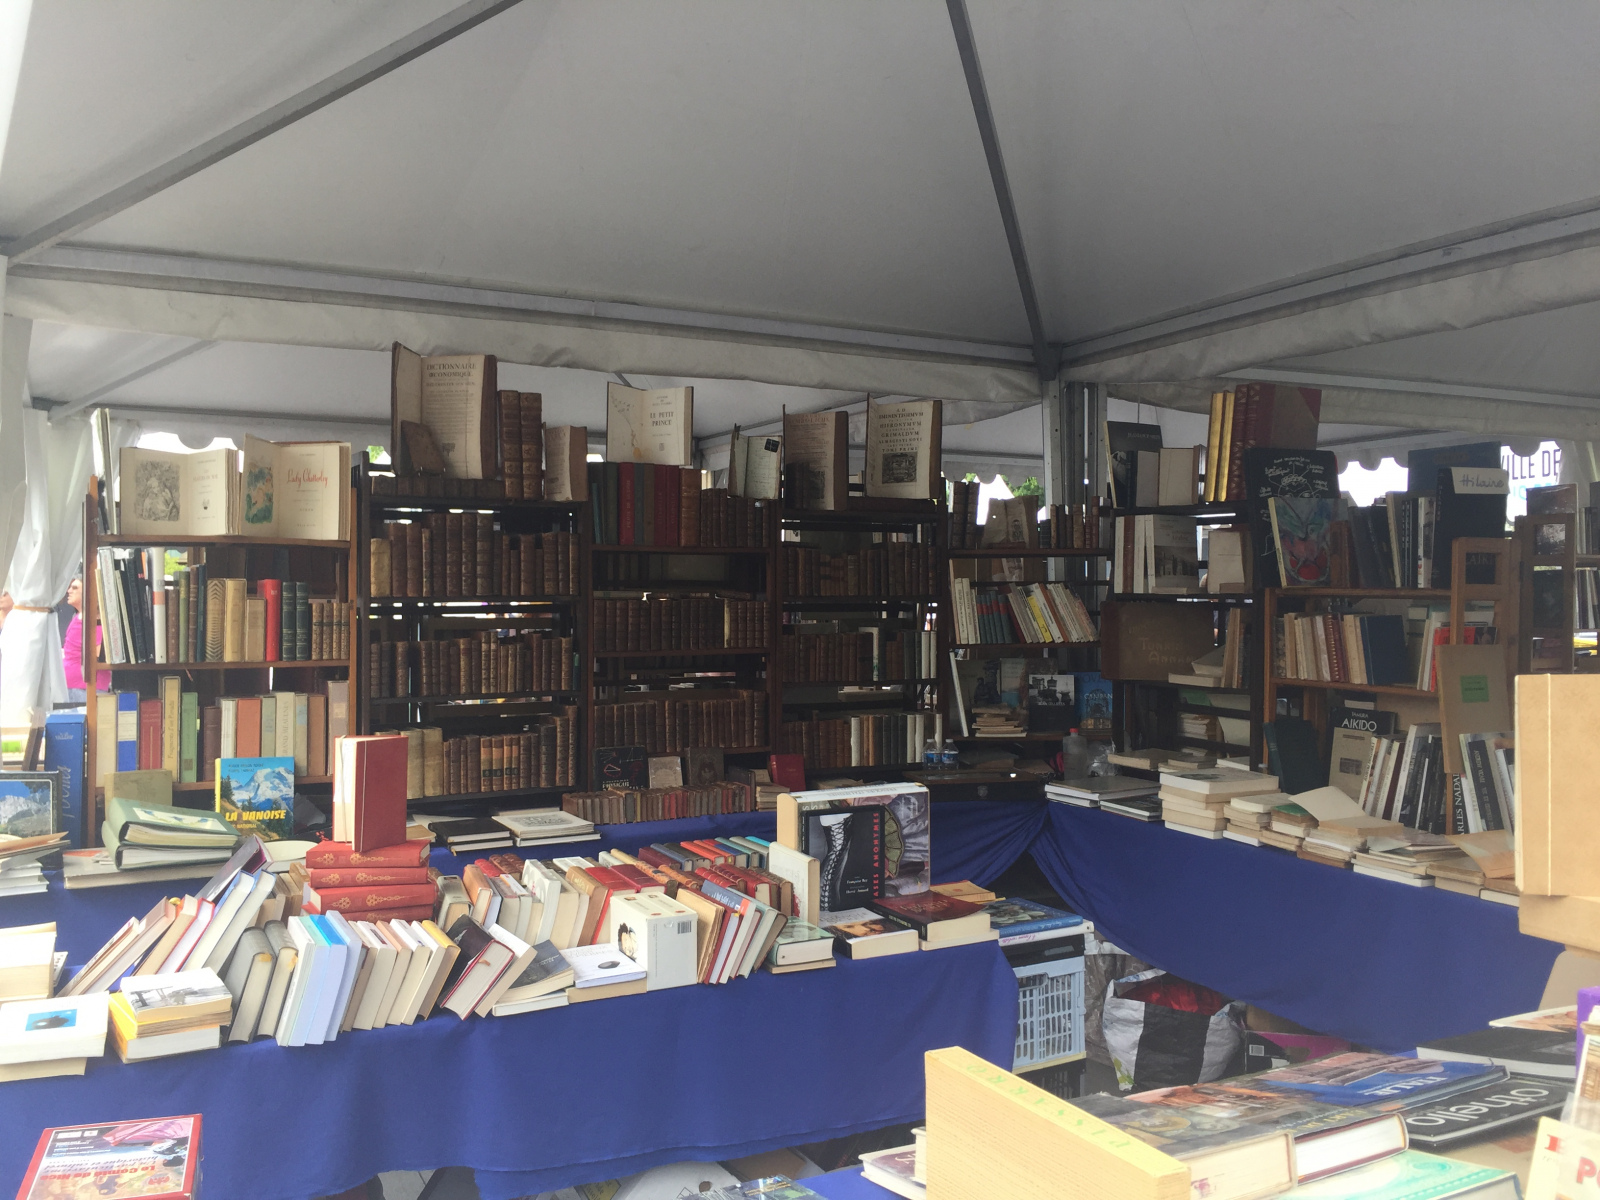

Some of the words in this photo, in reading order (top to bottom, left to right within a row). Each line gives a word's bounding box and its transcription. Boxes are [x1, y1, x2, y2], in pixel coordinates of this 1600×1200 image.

[287, 468, 302, 488] Lady
[1459, 474, 1504, 488] Hilaire
[1341, 718, 1377, 732] AIKIDO
[225, 812, 238, 821] LA
[242, 810, 287, 821] VANOISE
[1364, 1076, 1449, 1096] ITALIE
[1406, 1088, 1549, 1126] othello
